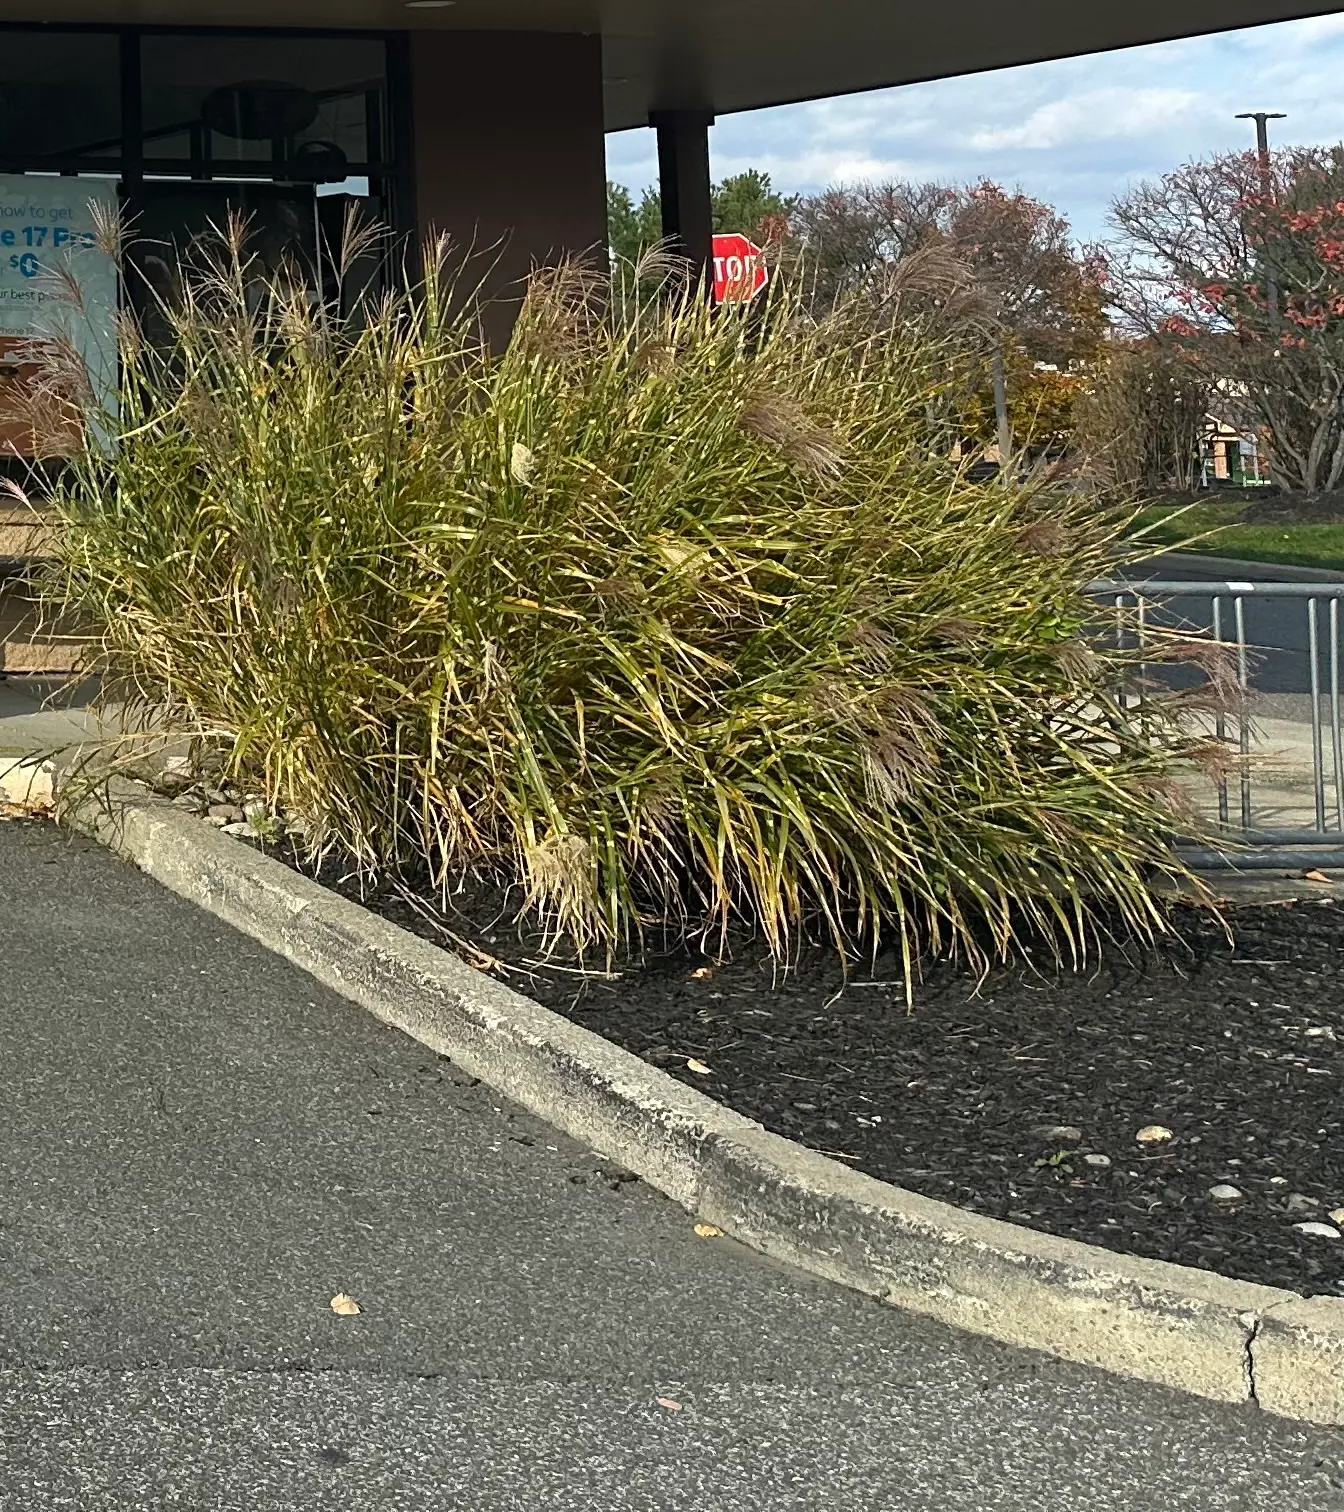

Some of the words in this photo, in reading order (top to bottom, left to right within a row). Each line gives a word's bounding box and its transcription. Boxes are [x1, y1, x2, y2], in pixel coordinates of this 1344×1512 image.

[29, 206, 46, 219] to
[49, 207, 73, 222] get
[21, 227, 48, 247] 17
[10, 252, 39, 278] $0
[10, 289, 36, 300] best
